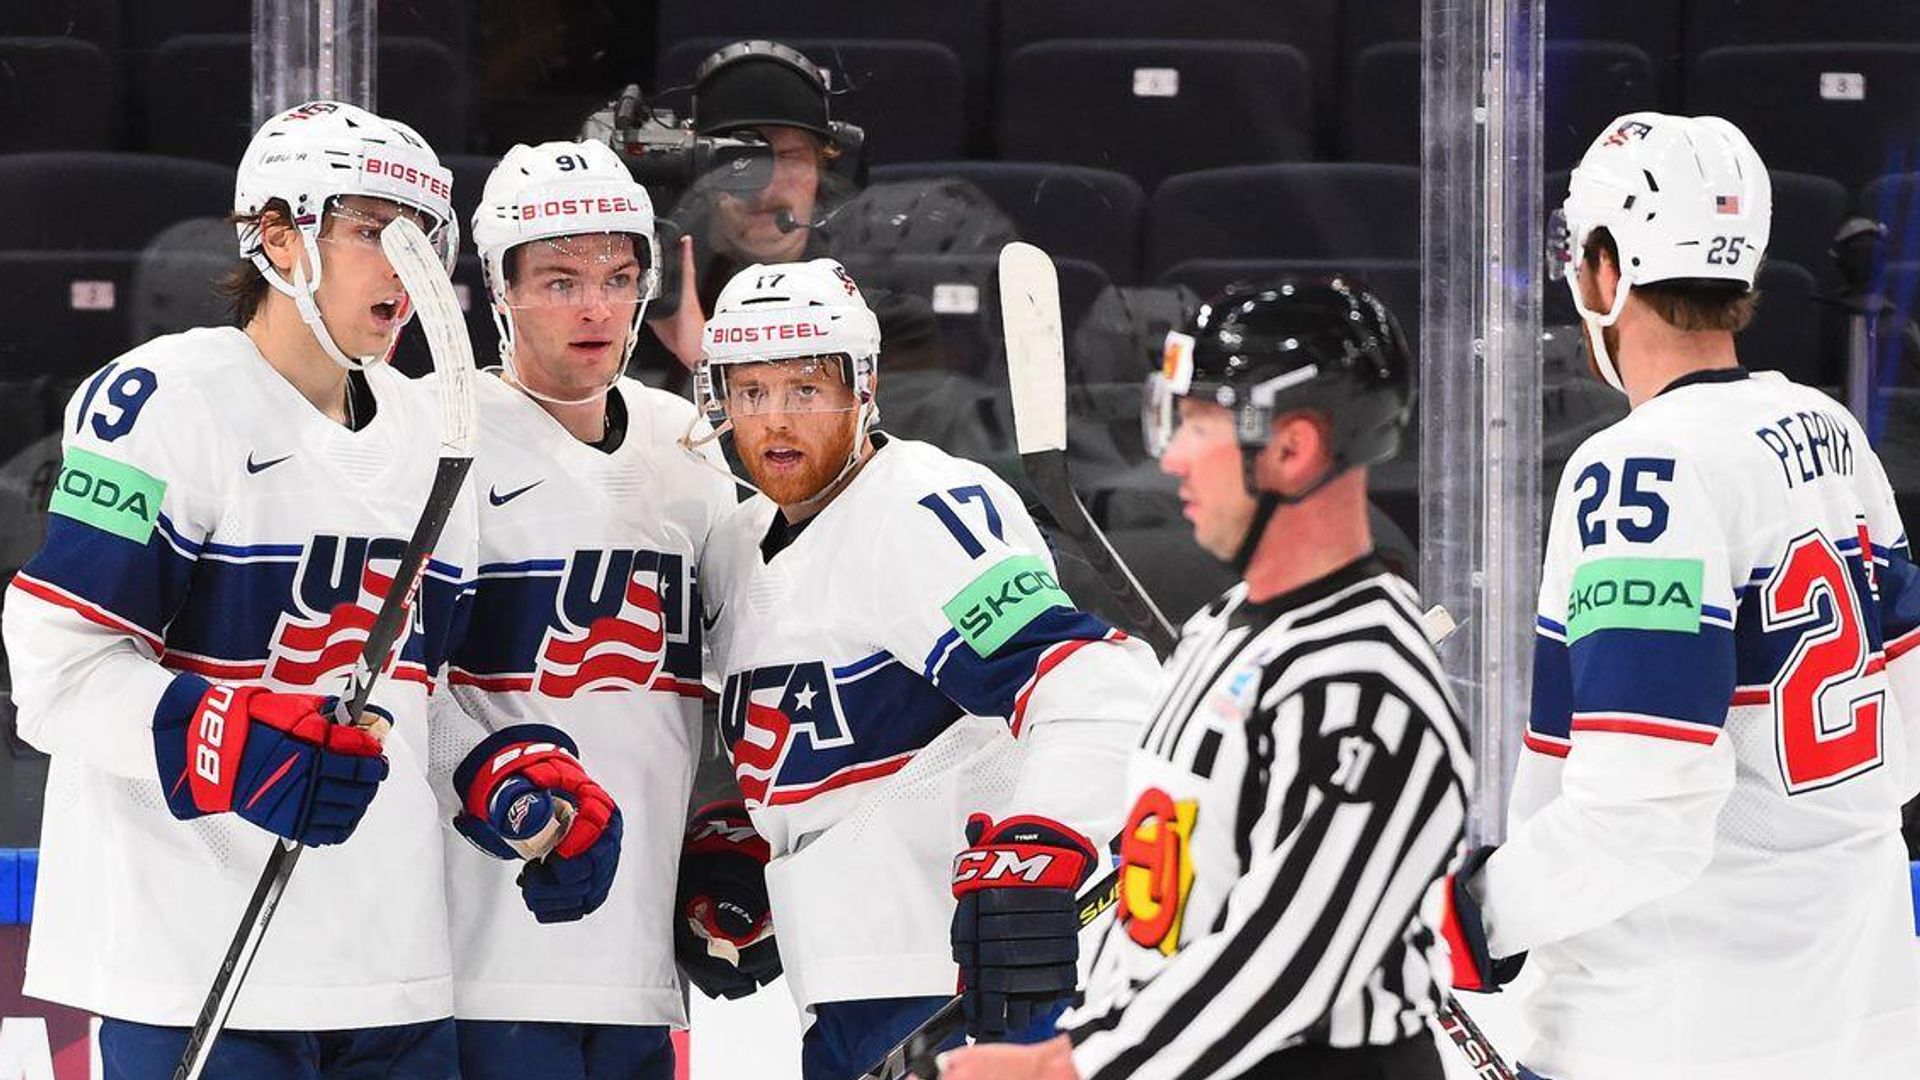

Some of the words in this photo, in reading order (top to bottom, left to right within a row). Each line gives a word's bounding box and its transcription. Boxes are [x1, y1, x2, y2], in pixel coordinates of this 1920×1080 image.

[556, 154, 588, 172] 91
[522, 197, 639, 220] BIOSTEEL
[1707, 236, 1746, 265] 25
[756, 274, 786, 289] 17
[713, 322, 829, 344] BIOSTEEL
[76, 362, 158, 443] 19
[918, 484, 1005, 560] 17
[1573, 458, 1676, 552] 25
[531, 547, 690, 700] USA
[718, 656, 855, 810] USA
